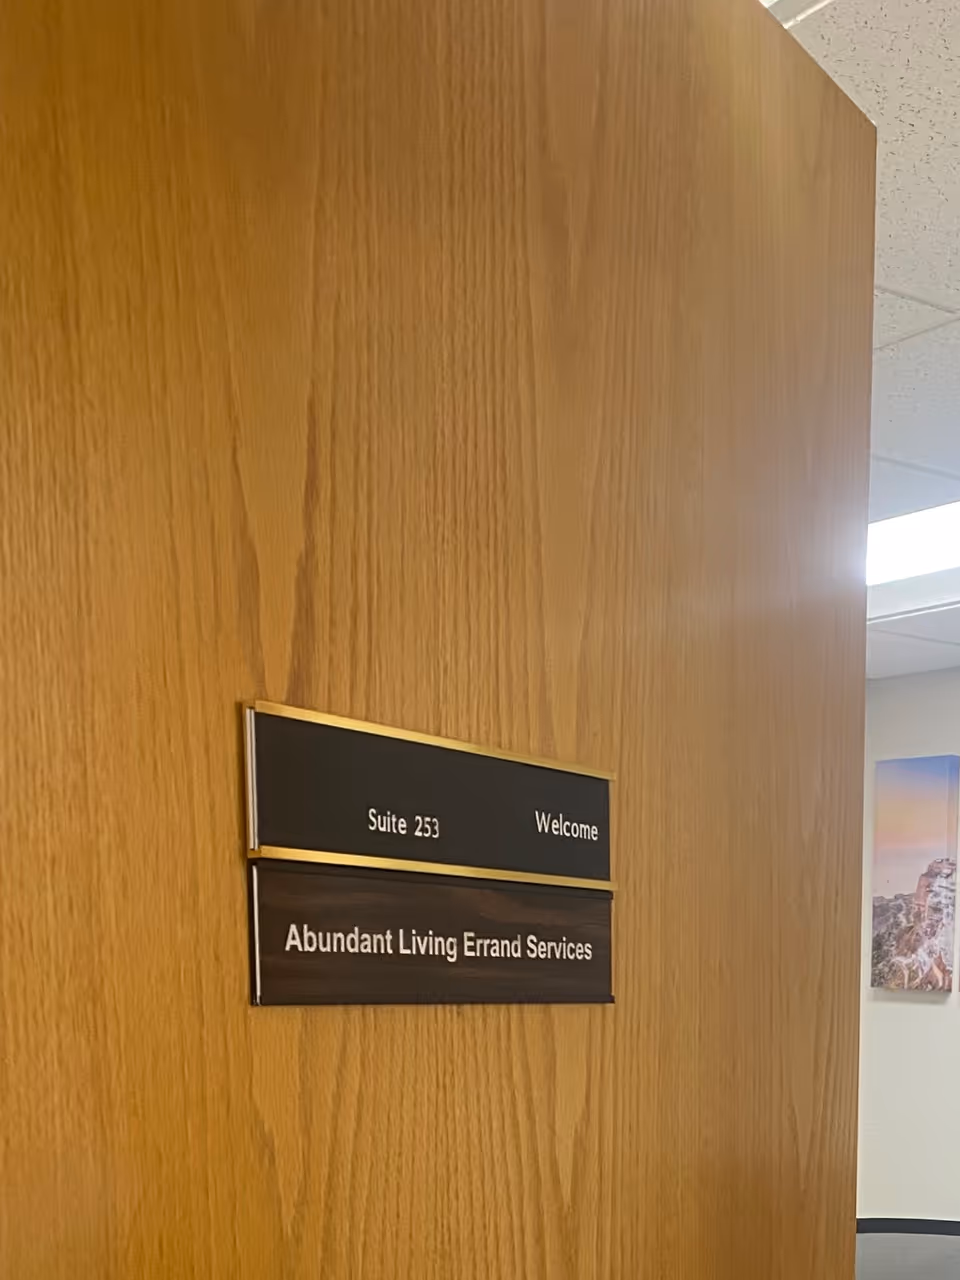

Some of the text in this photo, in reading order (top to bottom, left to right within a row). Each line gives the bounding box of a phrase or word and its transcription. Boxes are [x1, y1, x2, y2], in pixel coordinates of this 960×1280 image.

[368, 808, 440, 838] Suite 253
[535, 810, 599, 841] Welcome
[285, 923, 593, 963] Abundant Living Errand Services
